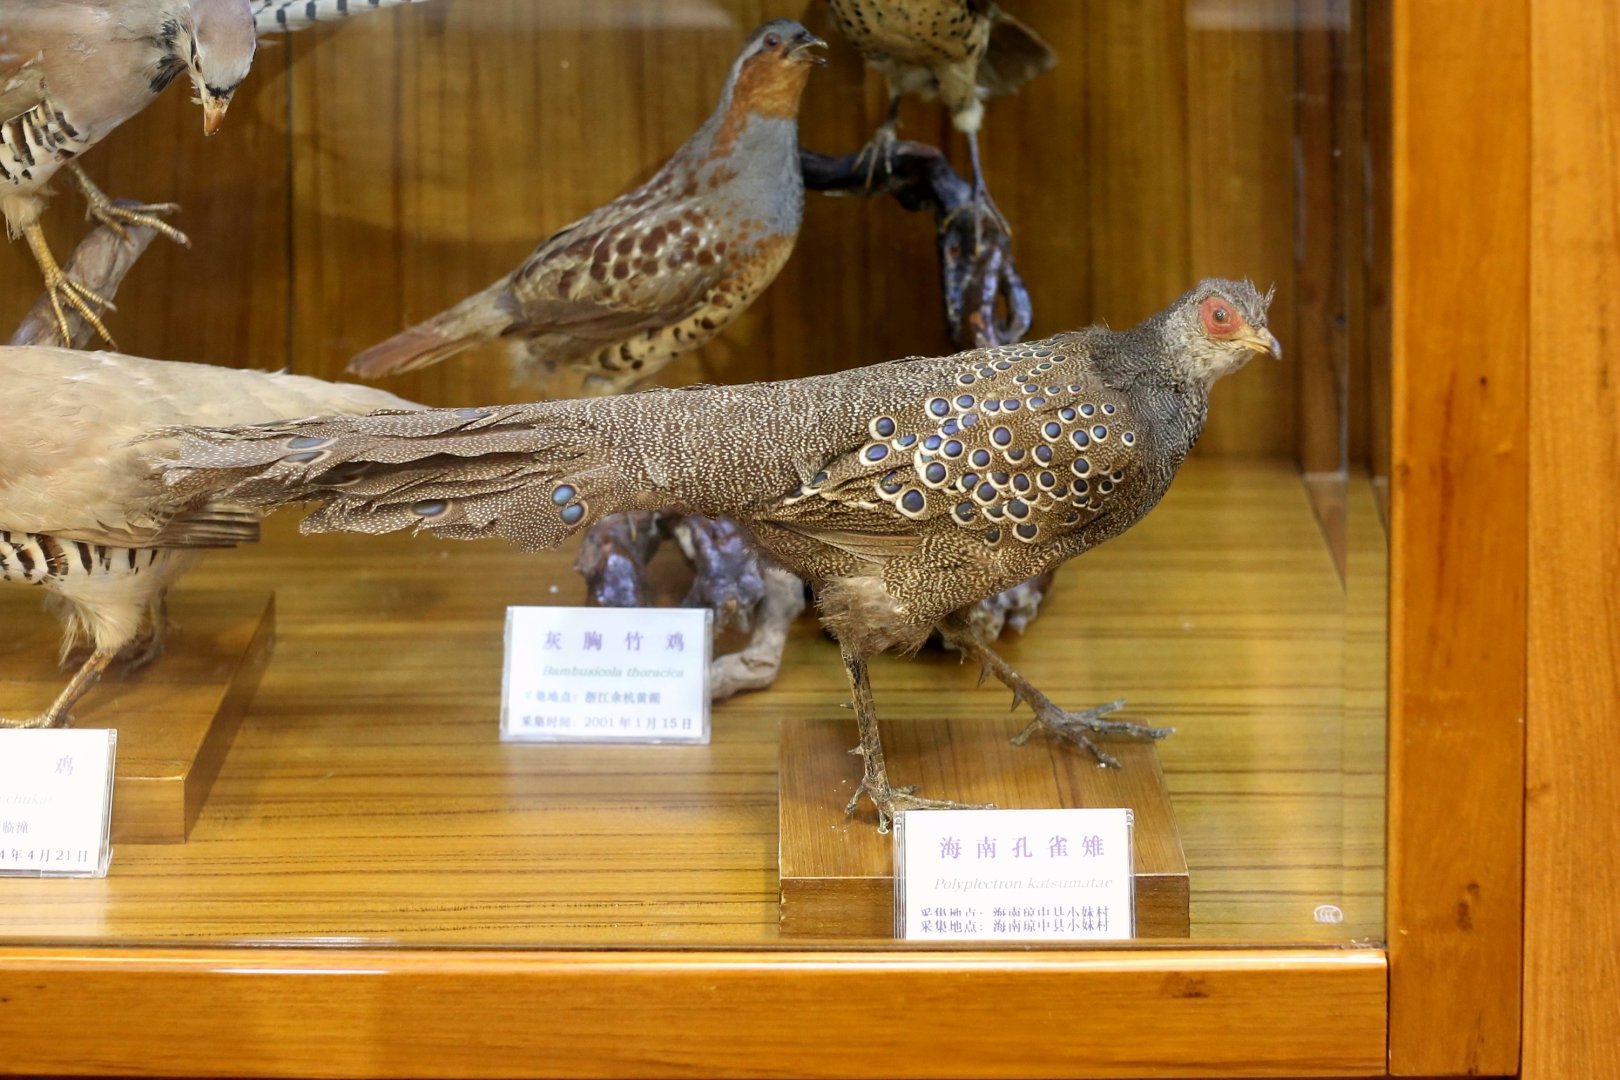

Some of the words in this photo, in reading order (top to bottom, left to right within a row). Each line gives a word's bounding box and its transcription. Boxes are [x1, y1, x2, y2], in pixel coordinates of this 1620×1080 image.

[543, 630, 685, 652] 灰胸竹鸡
[626, 666, 684, 679] thoracica
[939, 835, 1105, 859] 海南孔雀雉
[933, 878, 1023, 893] Polyplectron
[1027, 877, 1113, 890] katsumatae
